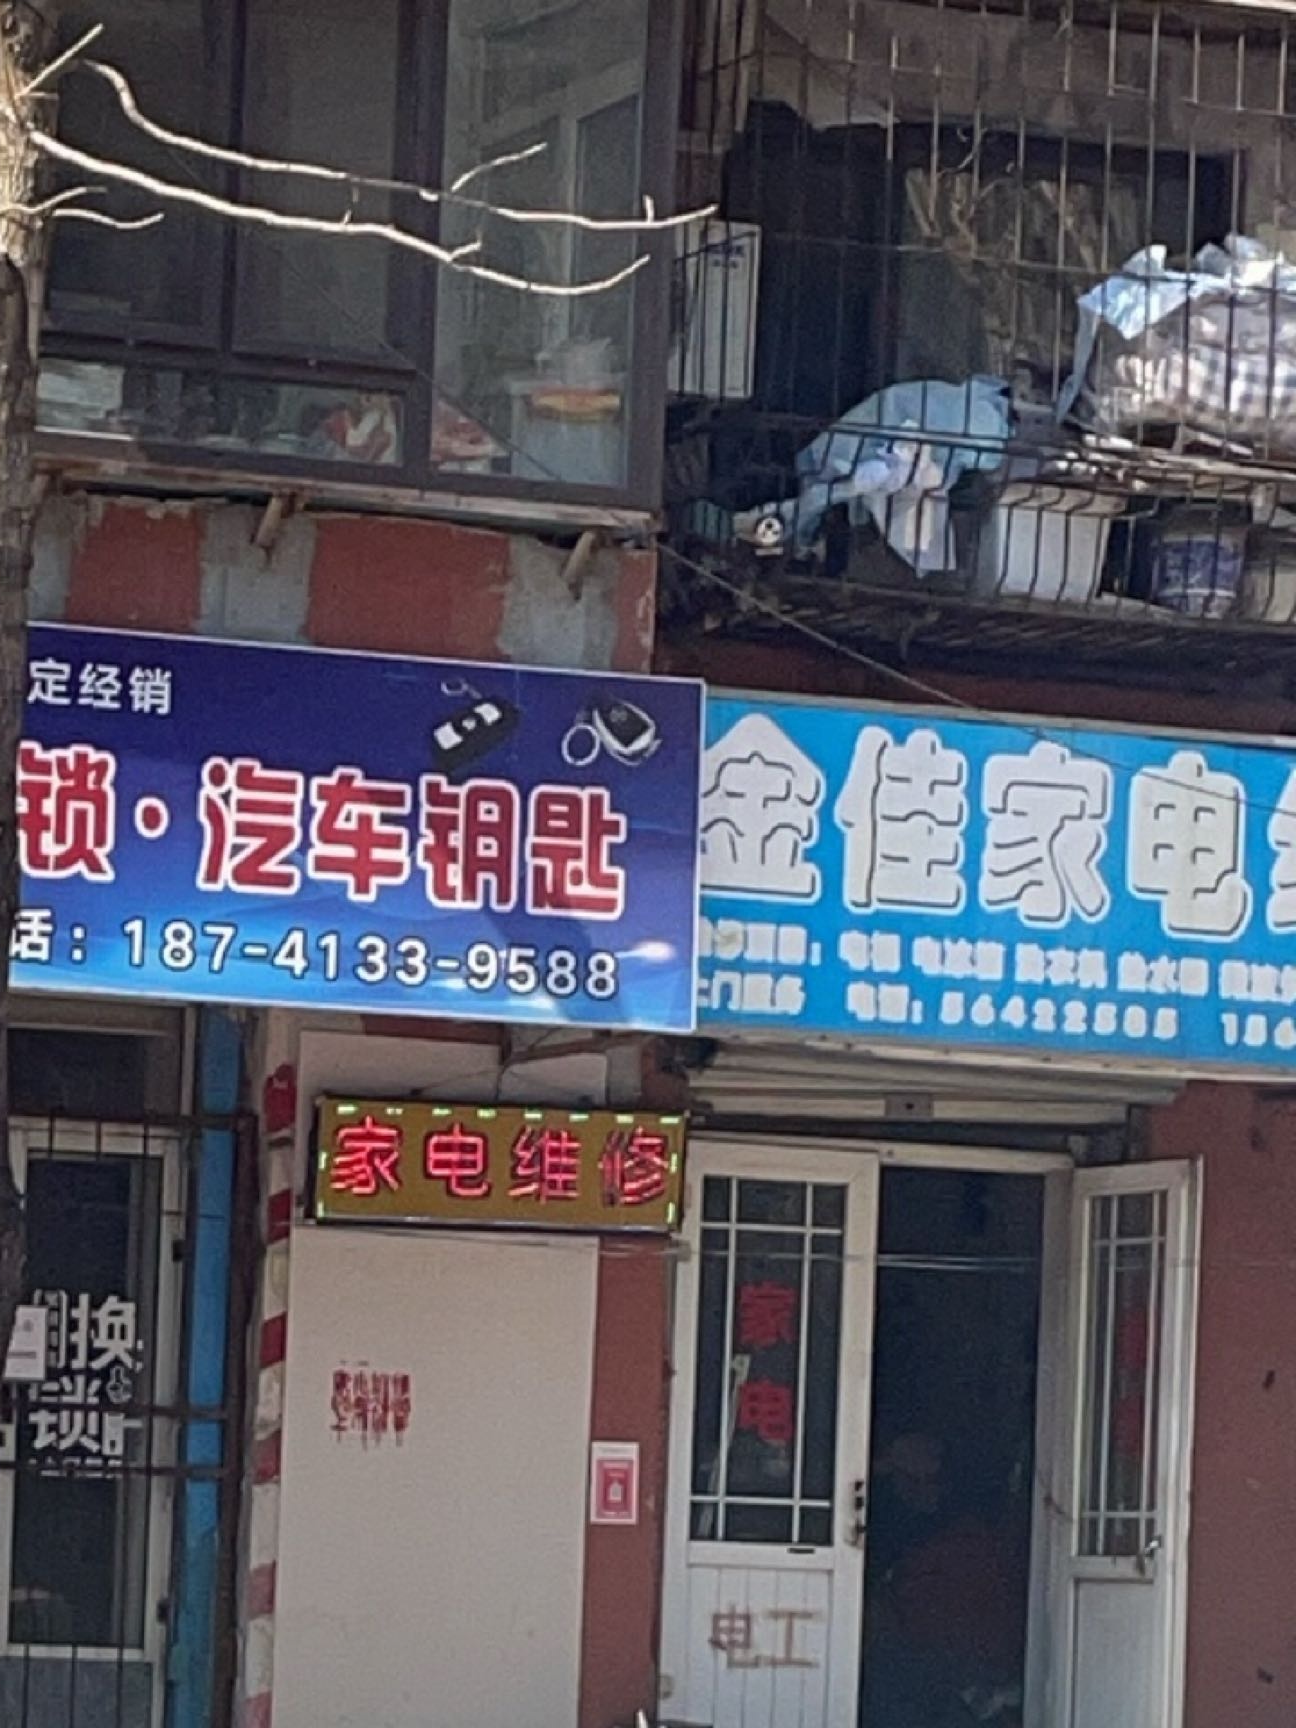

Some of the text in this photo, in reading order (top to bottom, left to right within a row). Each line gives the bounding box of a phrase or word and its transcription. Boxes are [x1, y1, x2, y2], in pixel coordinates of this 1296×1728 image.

[699, 712, 1296, 939] 金佳家电
[330, 1114, 670, 1205] 家电维修
[707, 1604, 820, 1669] 电工
